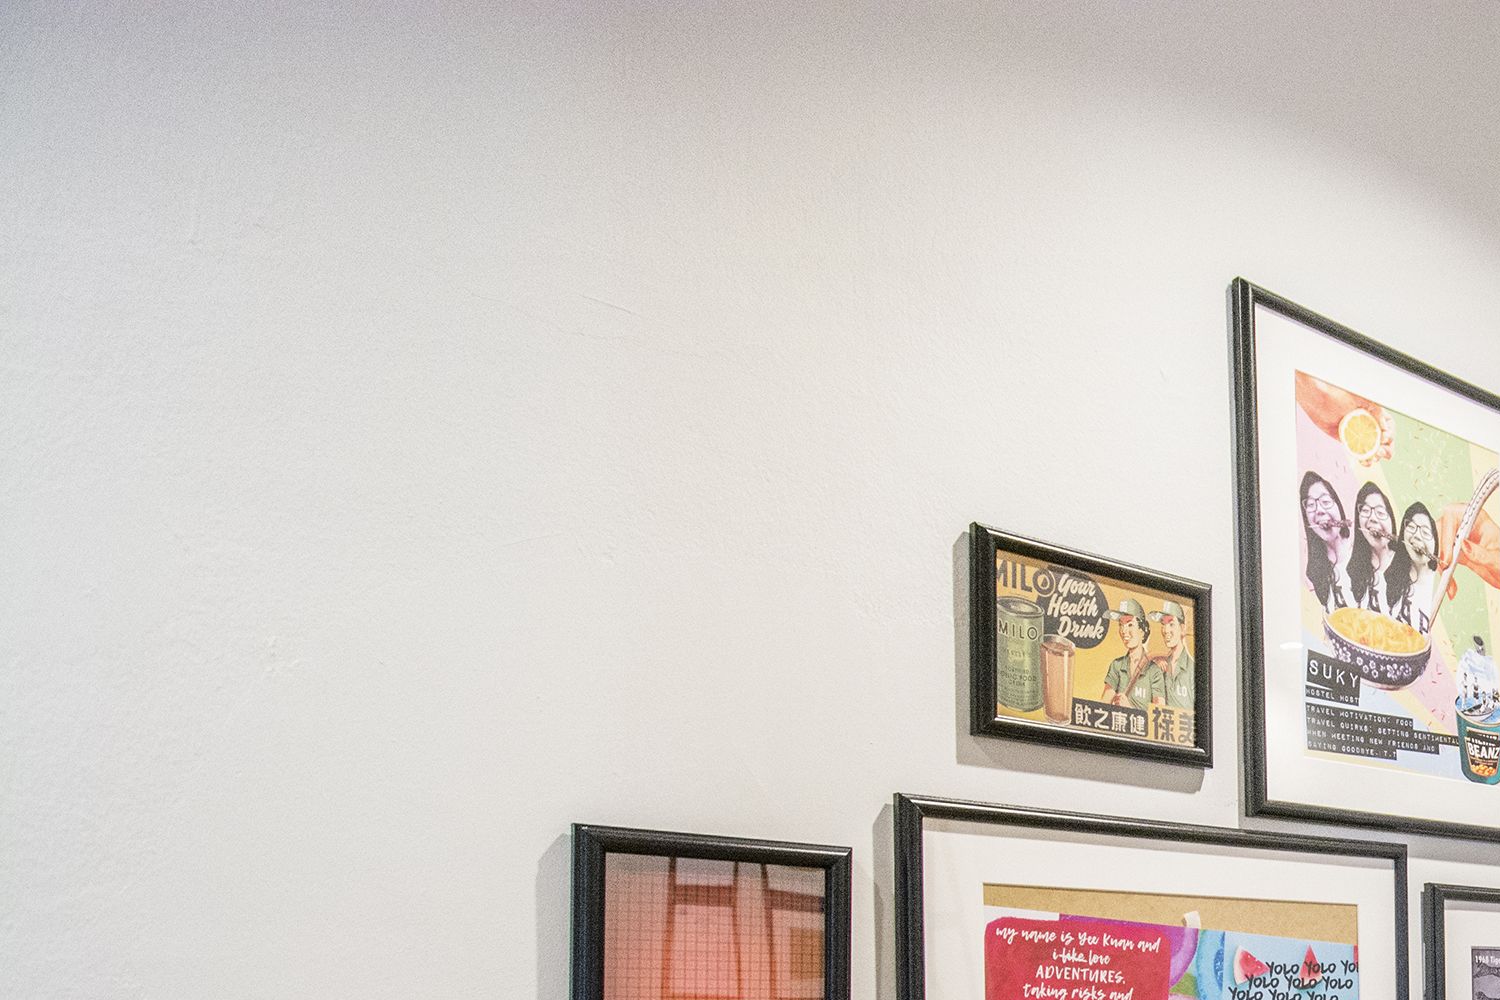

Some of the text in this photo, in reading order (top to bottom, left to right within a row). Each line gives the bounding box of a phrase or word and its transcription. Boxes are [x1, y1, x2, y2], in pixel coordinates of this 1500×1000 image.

[1058, 573, 1095, 597] Your
[1047, 593, 1098, 617] Health
[998, 619, 1038, 640] MILO
[1057, 615, 1104, 640] Drink
[1309, 659, 1358, 688] SUKY
[1134, 686, 1146, 698] MI
[1306, 687, 1359, 704] HOSTEL HOST
[1306, 704, 1335, 716] TRAVEL
[1340, 711, 1391, 724] MOTIVATION:
[1307, 716, 1335, 728] TRAVEL
[1378, 727, 1409, 738] GETTING
[1413, 732, 1459, 745] SENTIMENTAL
[1307, 729, 1326, 738] WHEN
[1332, 732, 1364, 743] MEETING
[1370, 737, 1383, 745] NEW
[1388, 739, 1419, 751] FRIENDS
[1308, 740, 1336, 751] SAYING
[1468, 742, 1500, 759] BEANZ
[996, 926, 1018, 944] my
[1021, 930, 1057, 943] name
[1060, 930, 1074, 945] is
[1078, 931, 1099, 946] Yee
[1137, 937, 1161, 953] and
[1088, 949, 1110, 966] love
[1265, 961, 1299, 978] YOLO
[1304, 961, 1336, 976] YOLO
[1245, 974, 1354, 992] YOLO YOLO YOLO
